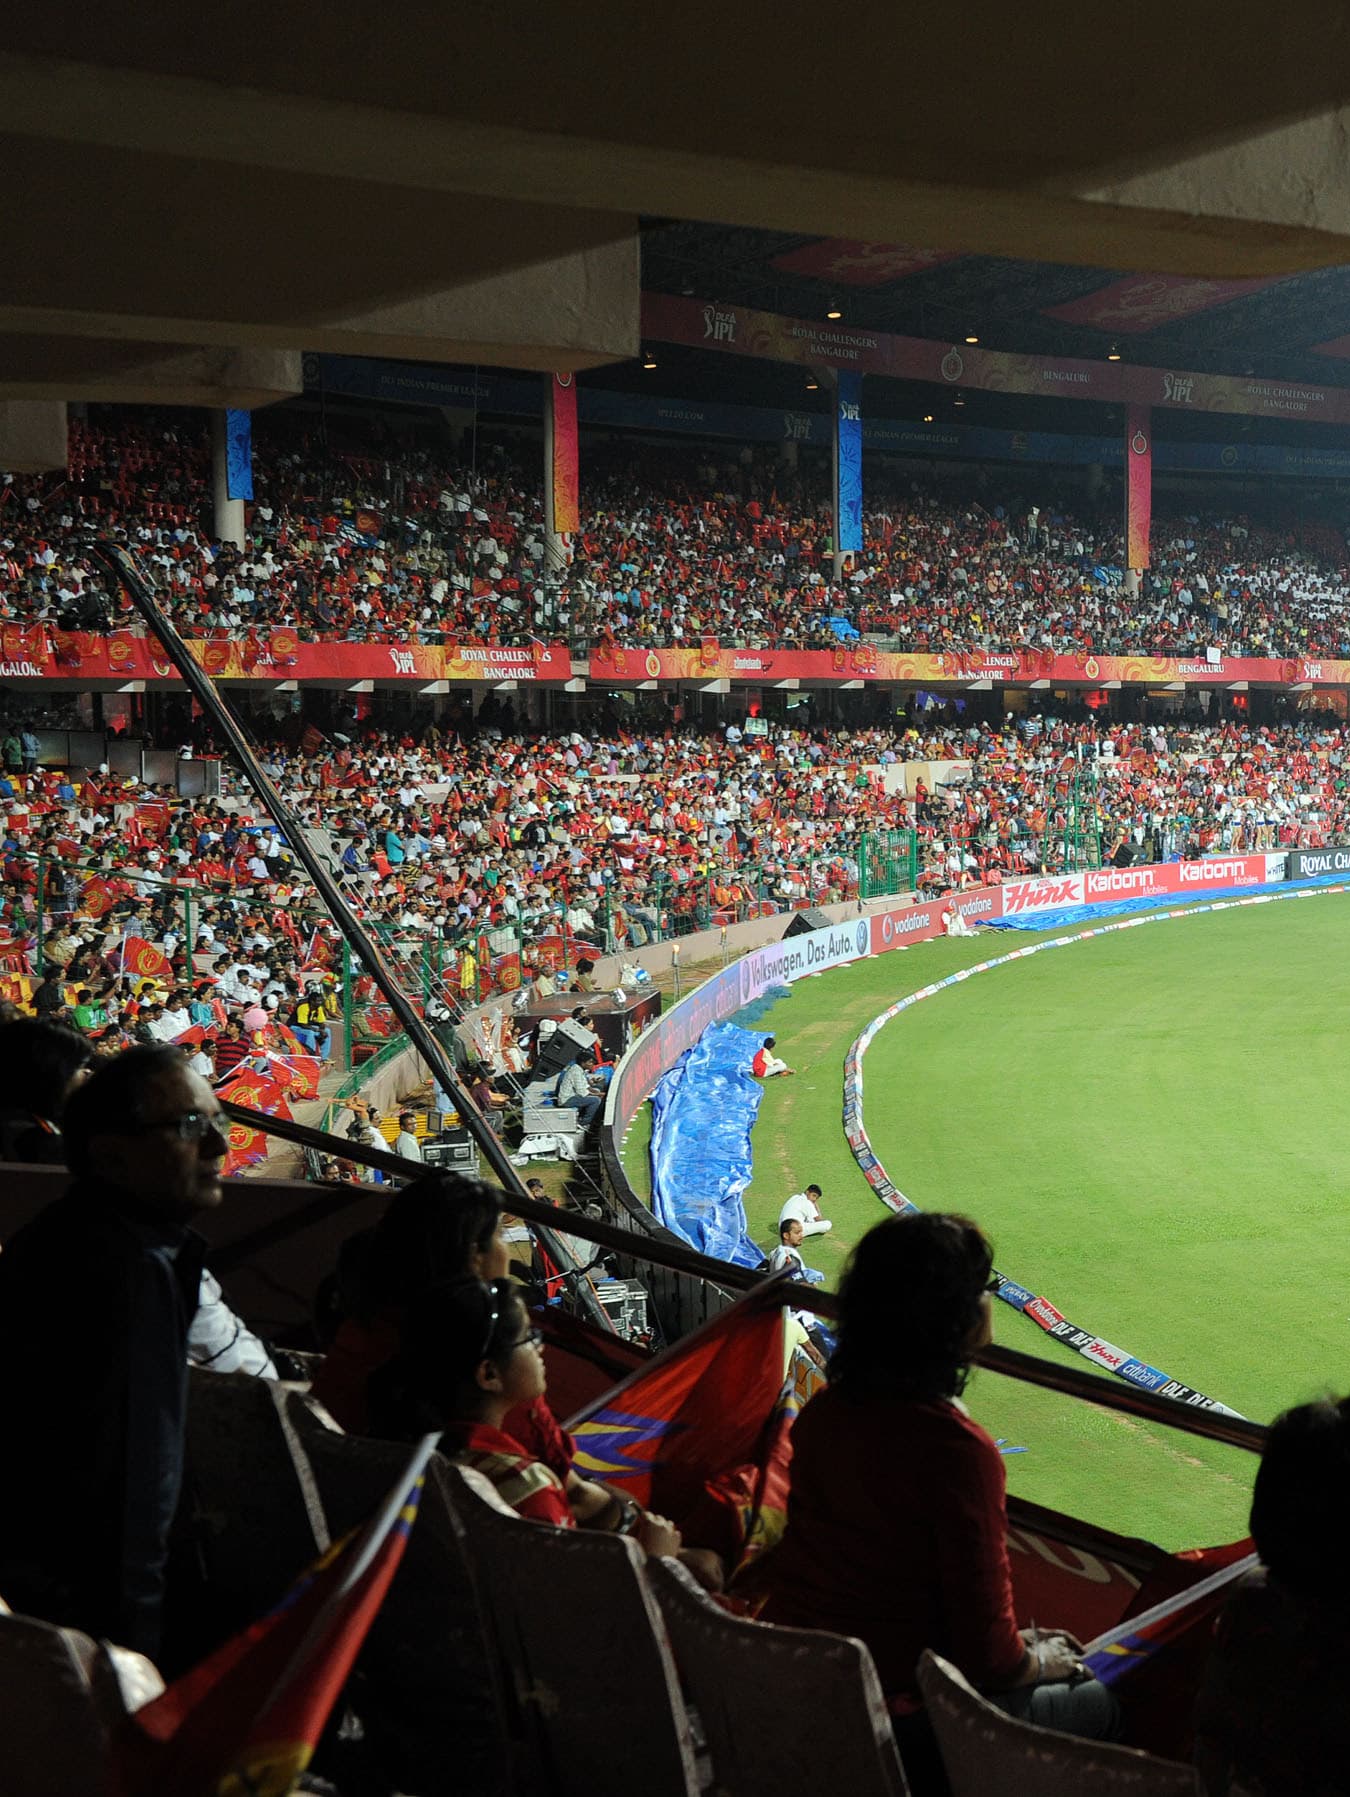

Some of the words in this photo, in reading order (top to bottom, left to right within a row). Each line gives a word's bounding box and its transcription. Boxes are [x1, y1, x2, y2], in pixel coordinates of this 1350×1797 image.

[714, 322, 736, 342] IPL
[792, 327, 817, 340] ROYAL
[819, 330, 878, 349] CHALLENGERS
[811, 344, 860, 360] BANGALORE
[1172, 387, 1193, 403] IPL
[1263, 399, 1309, 412] BANGALORE
[460, 649, 488, 661] ROYAL
[490, 650, 552, 662] CHALLENS
[400, 660, 417, 674] IPL
[483, 667, 537, 679] BANGALORE
[1178, 664, 1225, 674] BENGALURU
[1310, 670, 1324, 679] IPL
[1180, 860, 1245, 882] Karbonn
[1300, 854, 1333, 876] ROYAL
[1088, 869, 1154, 893] Karbonn
[1142, 884, 1168, 896] Mobiles
[1234, 874, 1259, 886] Mobiles
[959, 896, 992, 916] vodafone
[1005, 880, 1080, 913] Hunk
[894, 912, 930, 934] vodafone
[808, 938, 827, 964] Das
[829, 933, 853, 956] Auto.
[1053, 1322, 1075, 1336] DLF
[1070, 1332, 1094, 1347] DLF
[1090, 1342, 1122, 1367] Hunk
[1122, 1363, 1161, 1388] citibank
[1162, 1382, 1188, 1399] DLF
